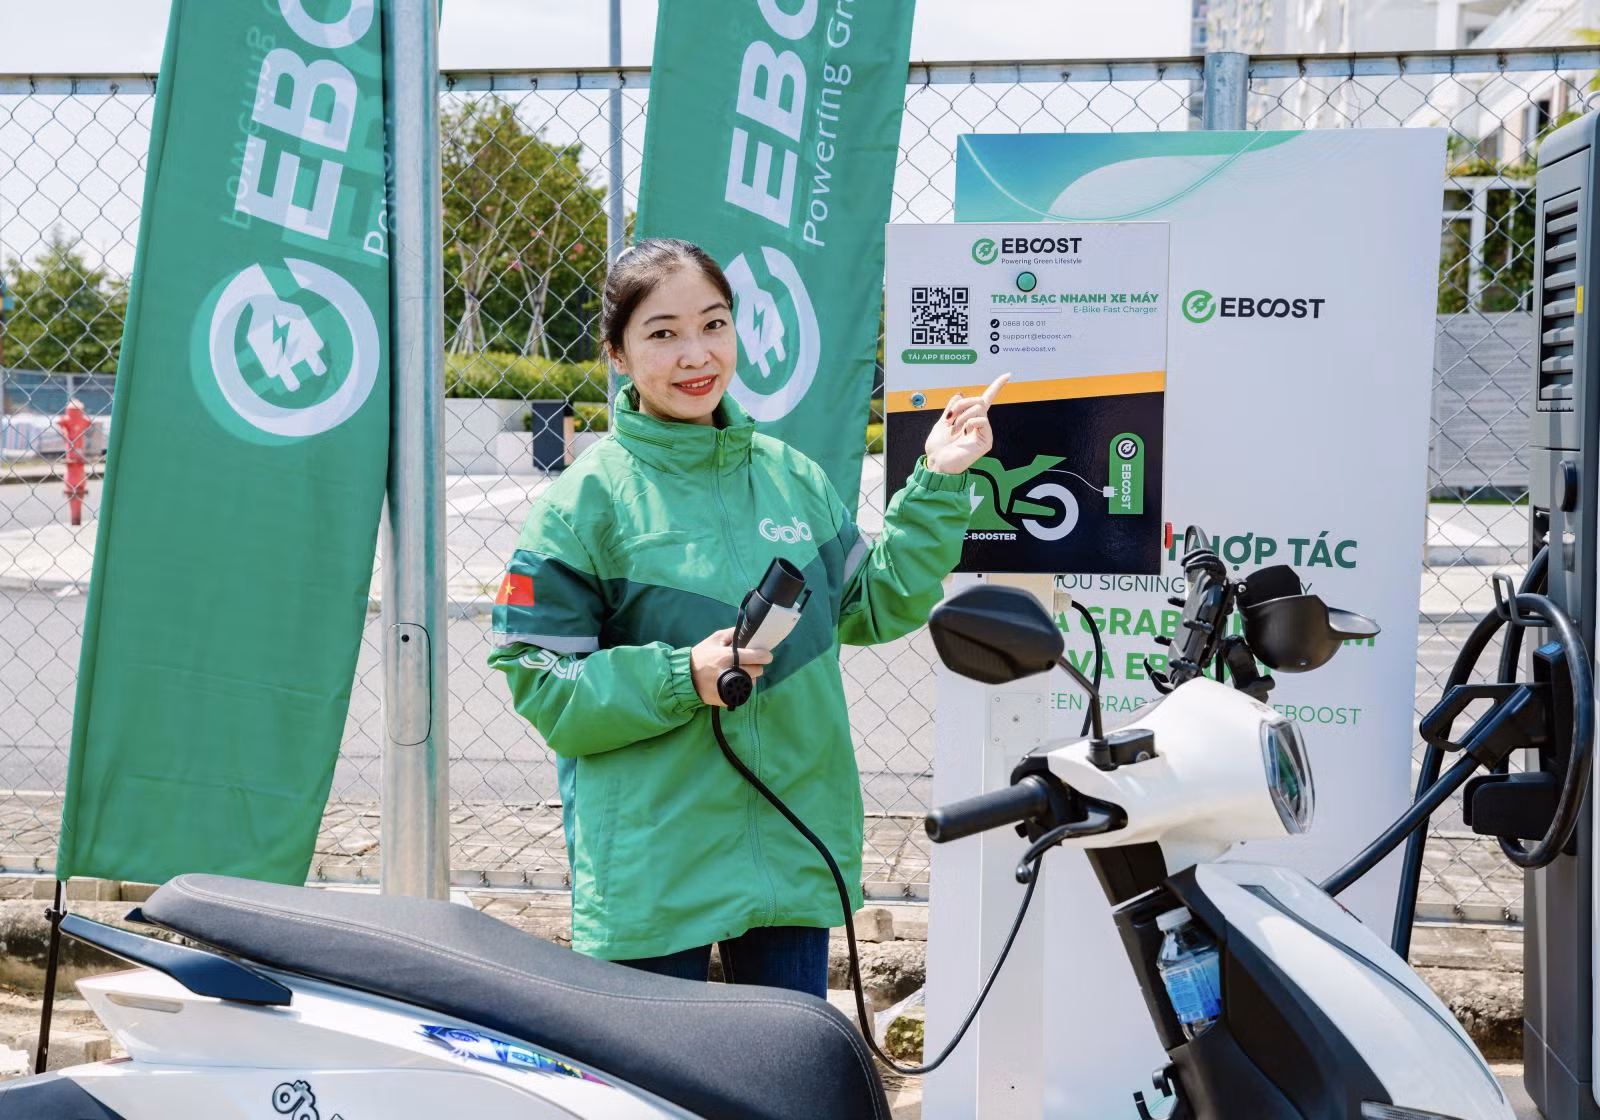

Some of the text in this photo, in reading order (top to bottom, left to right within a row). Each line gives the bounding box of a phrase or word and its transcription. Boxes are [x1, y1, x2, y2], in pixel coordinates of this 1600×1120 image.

[802, 0, 854, 247] Powering Gr
[1001, 237, 1082, 254] EBOOST
[1001, 257, 1032, 266] Powering
[1054, 257, 1082, 265] Lifestyle
[991, 291, 1159, 306] TRẠM SẠC NHANH XE MÁY
[1220, 297, 1325, 319] EBOOST
[1122, 306, 1158, 315] Charger
[1002, 333, 1072, 341] support@eboost.vn
[1121, 464, 1132, 510] EBOOST
[758, 516, 813, 545] Grab
[1288, 530, 1358, 569] TÁC
[1099, 574, 1185, 594] SIGNING
[1080, 606, 1182, 637] GRAB
[1067, 643, 1115, 679] VÀ
